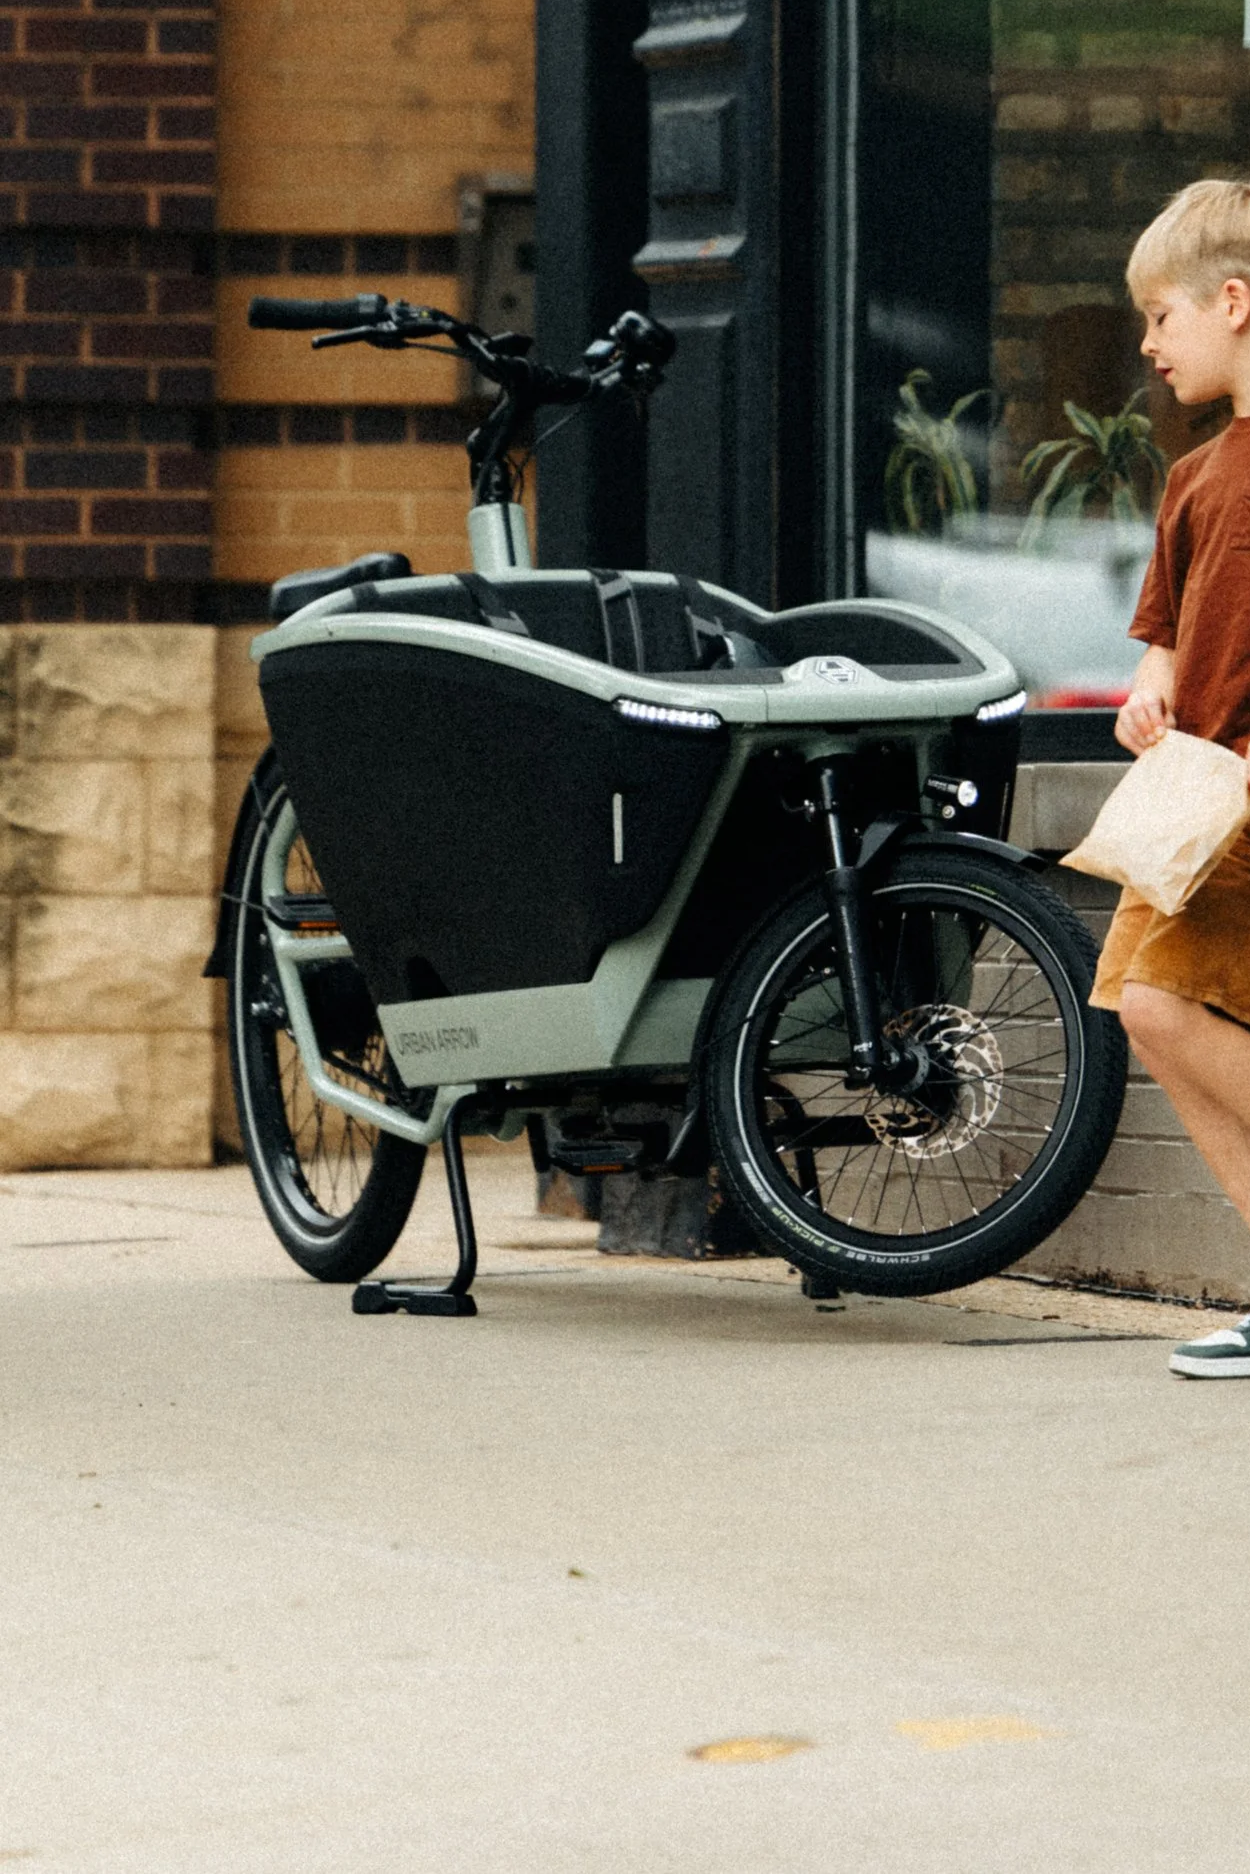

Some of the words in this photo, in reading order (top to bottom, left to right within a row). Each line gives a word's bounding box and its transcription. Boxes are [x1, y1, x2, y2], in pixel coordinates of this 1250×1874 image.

[394, 1031, 436, 1056] URBAN
[771, 1206, 825, 1247] PICK-UP
[846, 1249, 931, 1264] SCHWALBE
